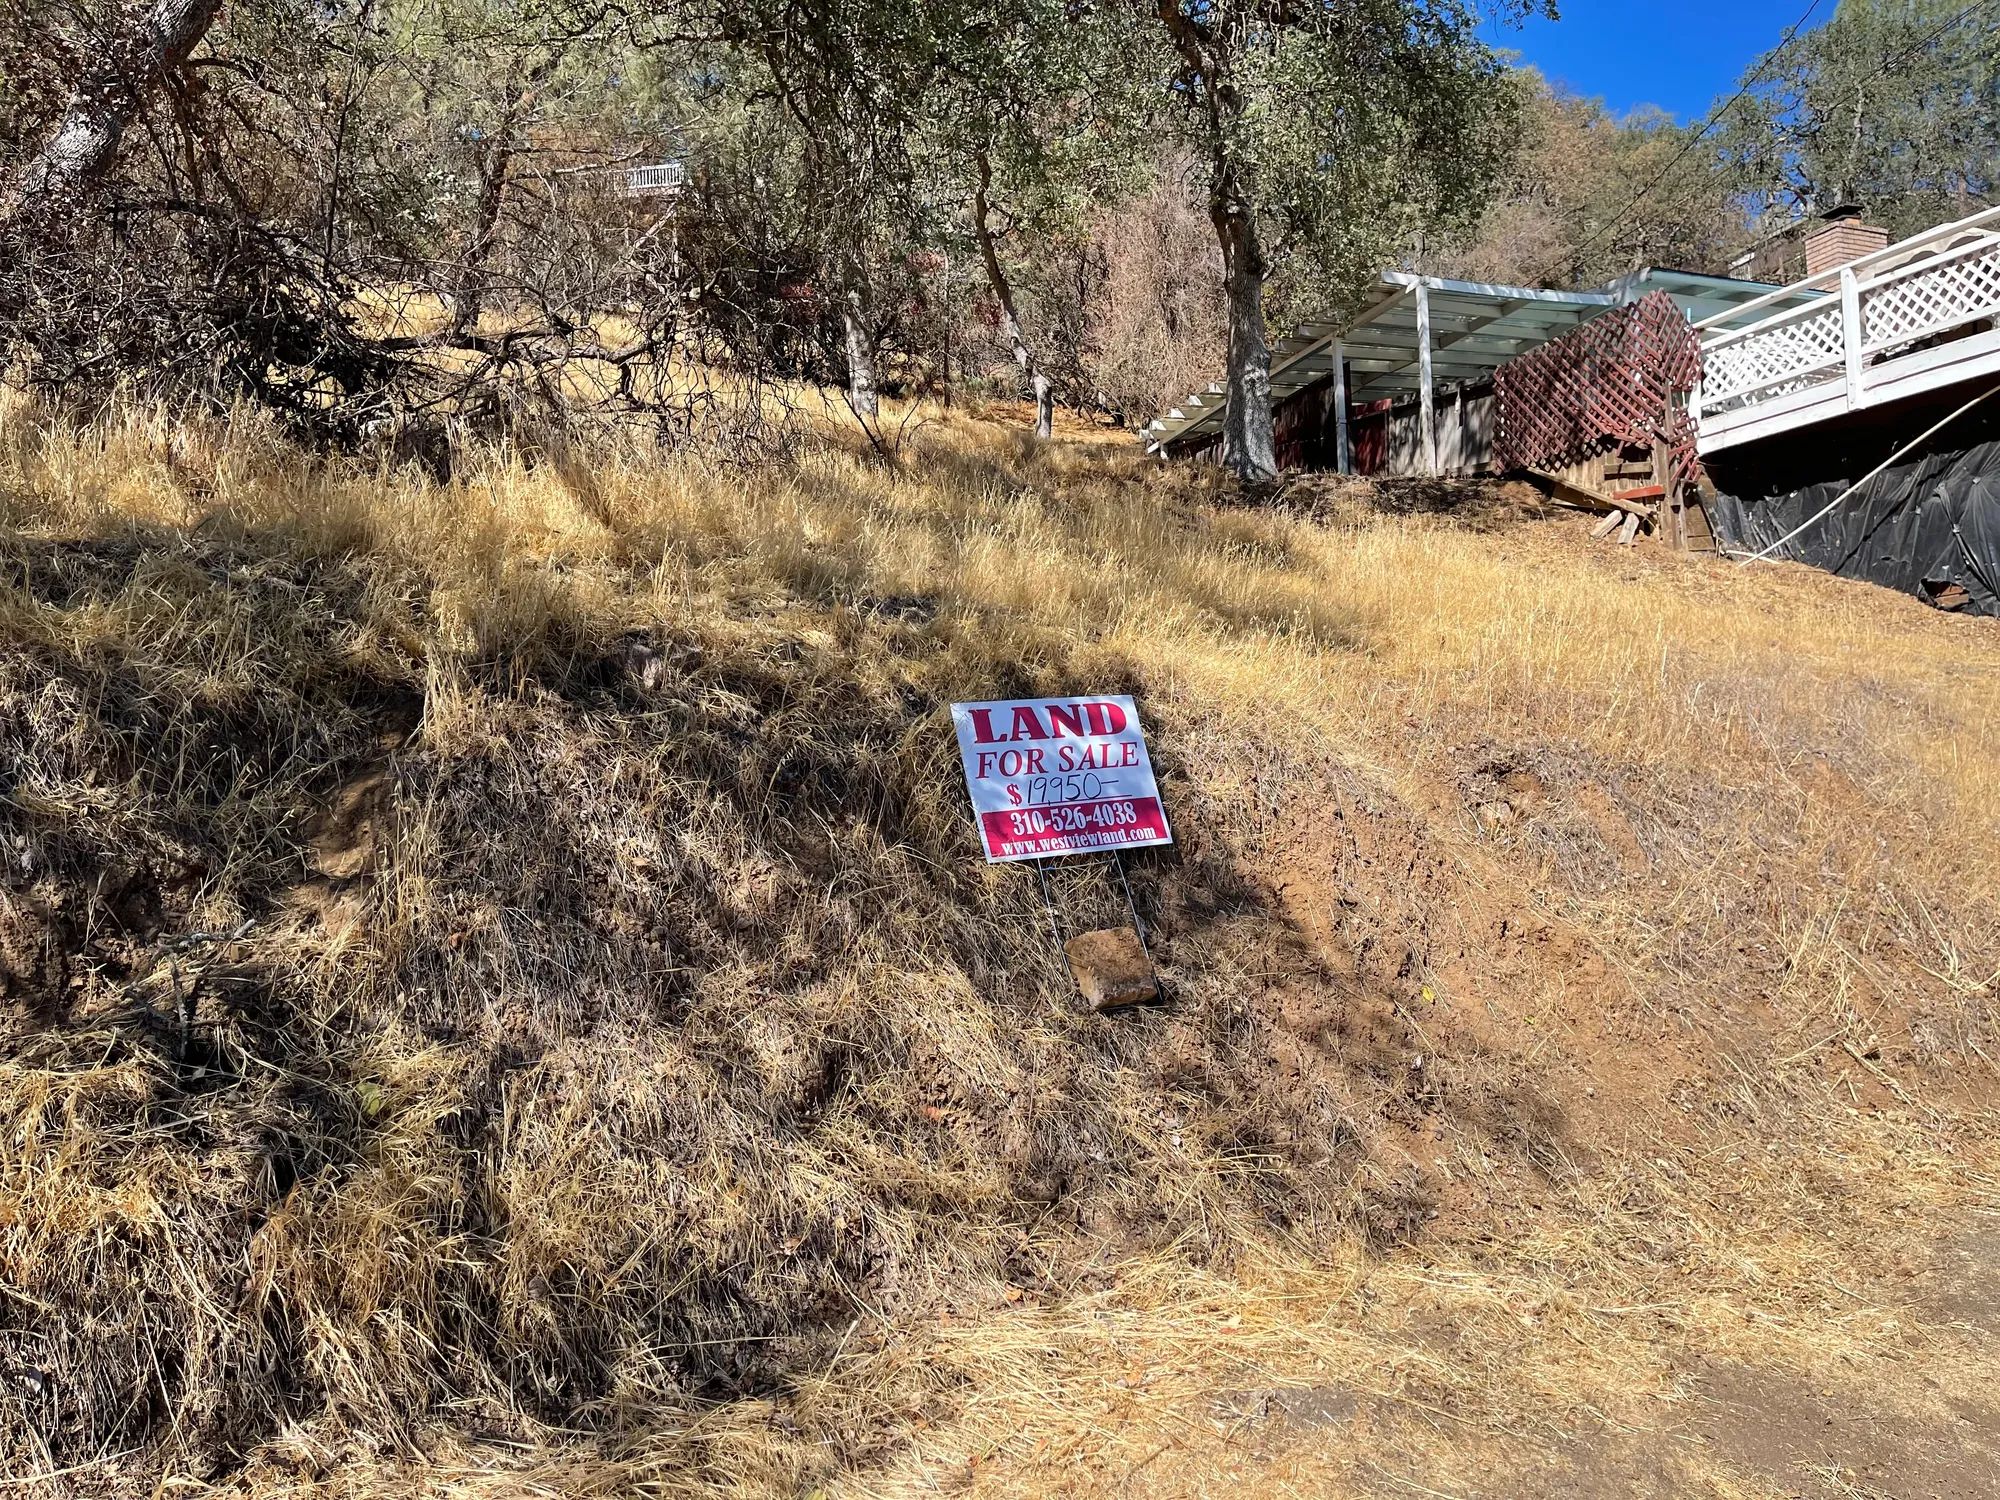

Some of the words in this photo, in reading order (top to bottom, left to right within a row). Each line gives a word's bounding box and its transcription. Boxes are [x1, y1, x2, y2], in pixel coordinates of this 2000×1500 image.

[968, 702, 1127, 744] LAND
[976, 748, 1048, 779] FOR
[1058, 741, 1140, 772] SALE
[1010, 801, 1137, 836] 310-526-4038
[1001, 826, 1157, 856] www.westviewland.com
